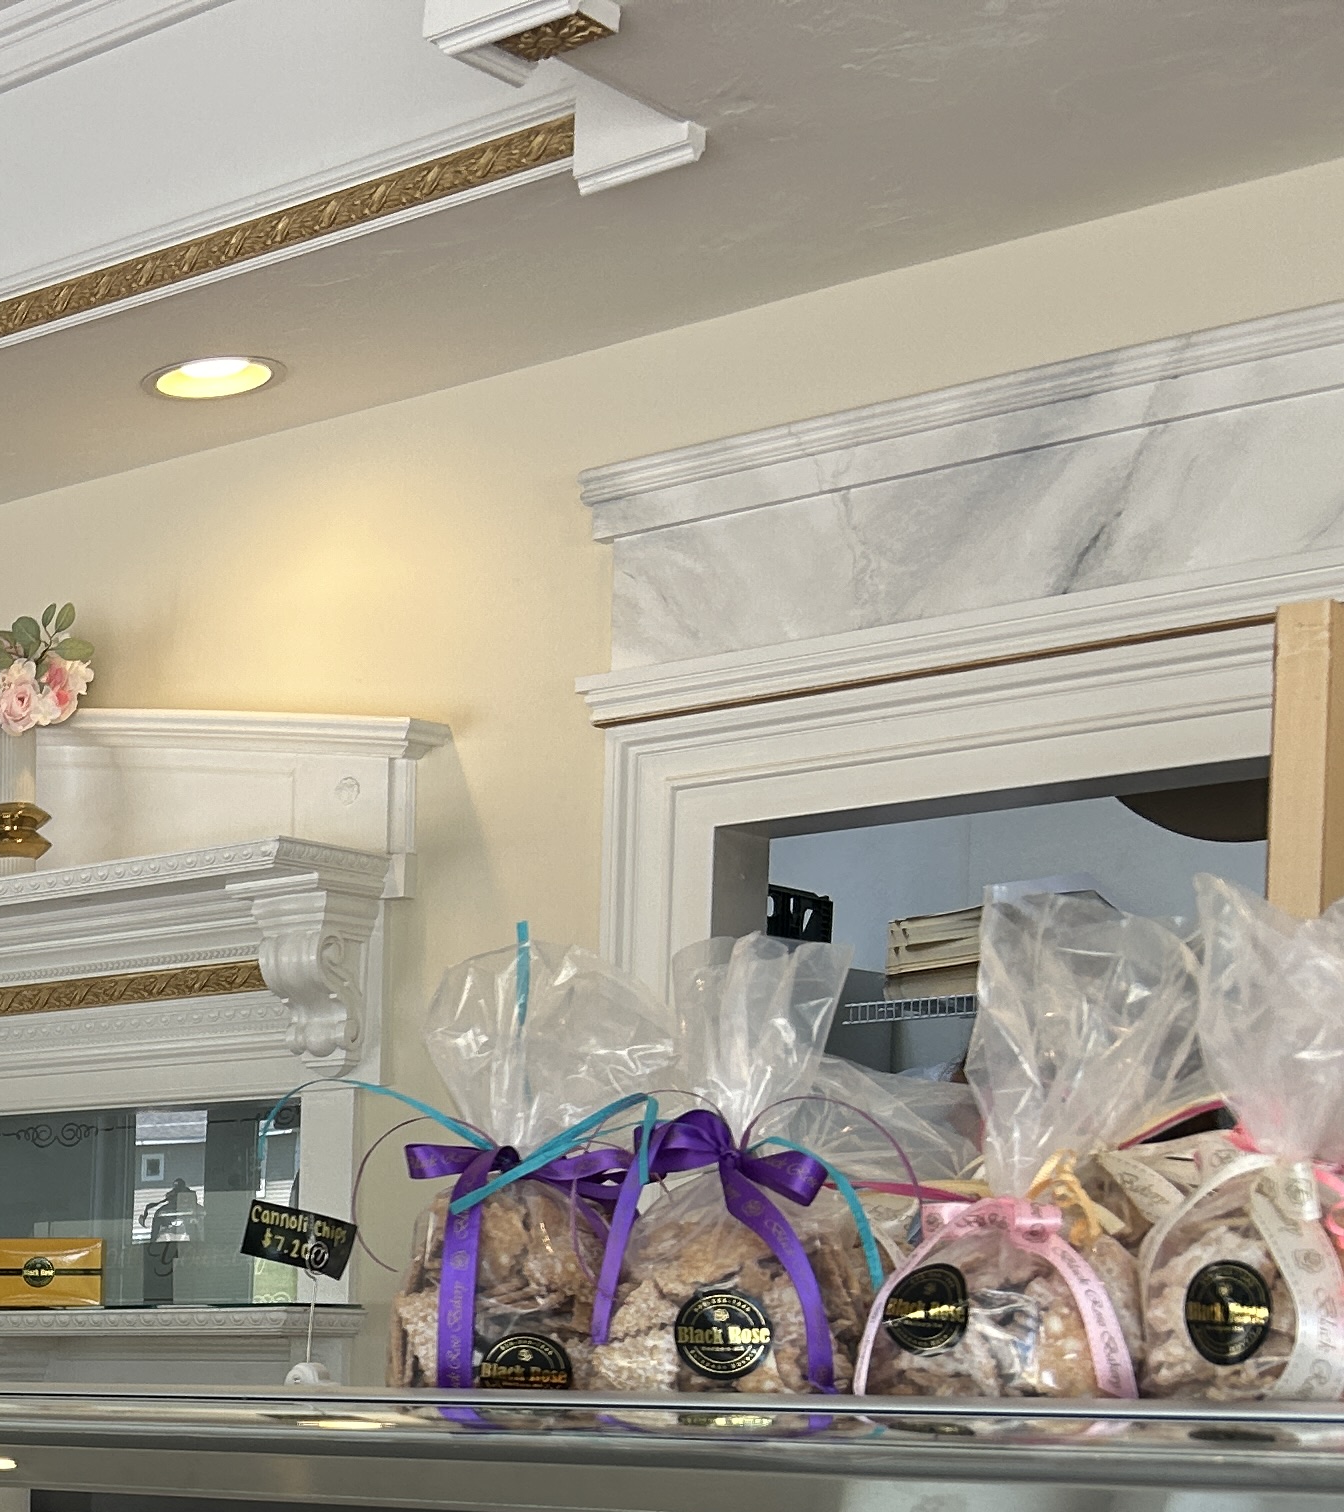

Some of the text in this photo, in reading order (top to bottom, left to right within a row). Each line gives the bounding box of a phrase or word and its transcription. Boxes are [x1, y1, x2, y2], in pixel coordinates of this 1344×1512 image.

[251, 1205, 348, 1247] Cannoli Chips
[677, 1325, 771, 1345] Black Rose
